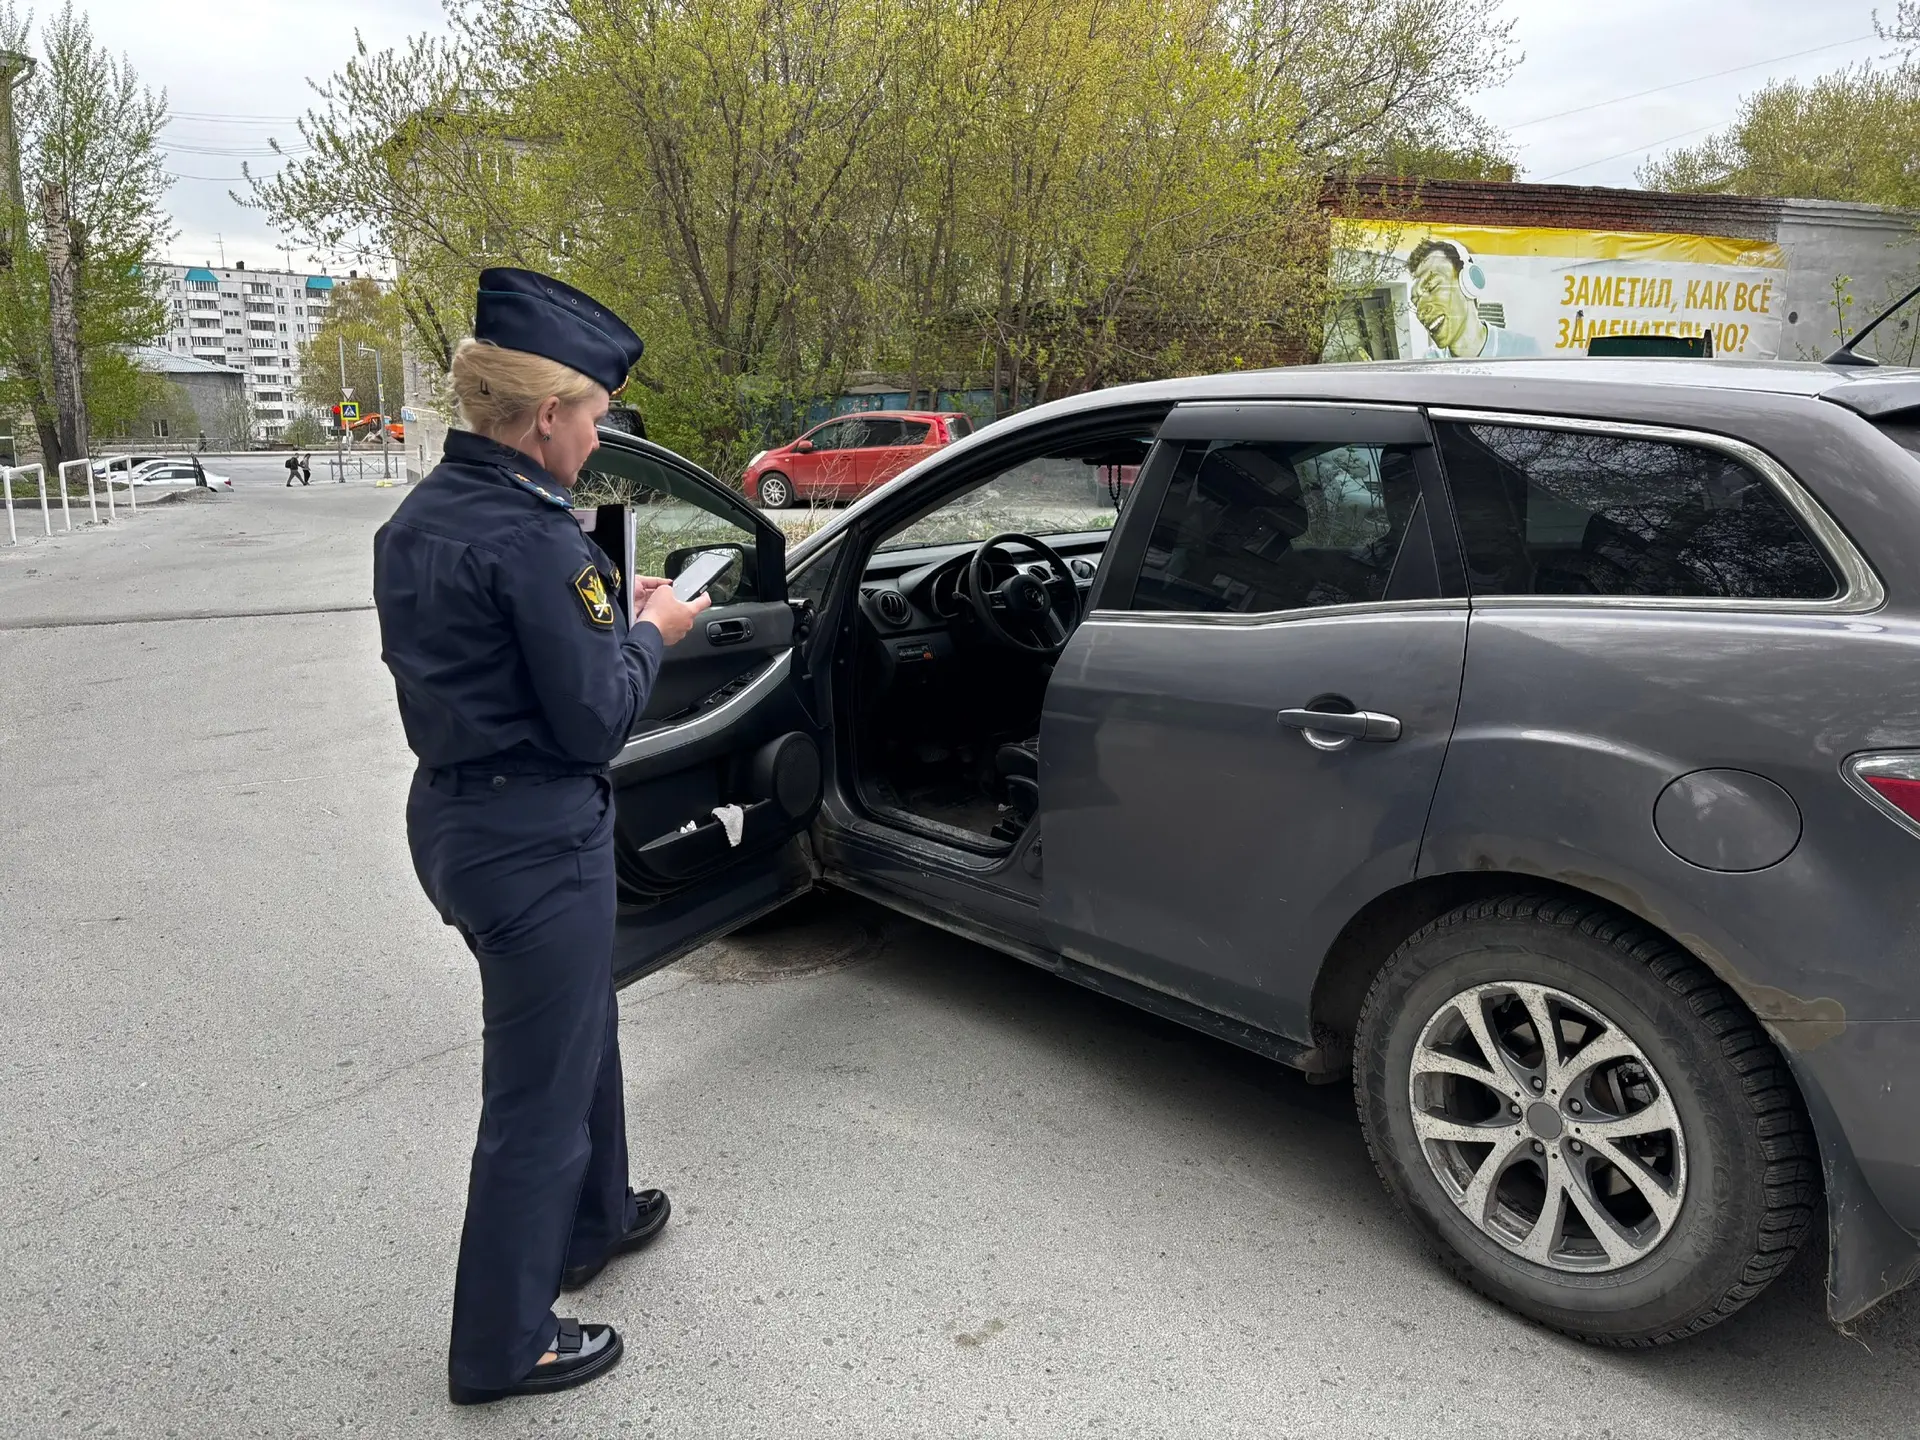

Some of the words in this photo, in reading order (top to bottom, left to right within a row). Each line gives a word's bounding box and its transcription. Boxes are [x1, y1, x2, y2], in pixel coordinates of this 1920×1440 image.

[1560, 274, 1677, 314] ЗАМЕТИЛ,
[1685, 279, 1731, 311] КАК
[1733, 277, 1774, 314] ВСЁ
